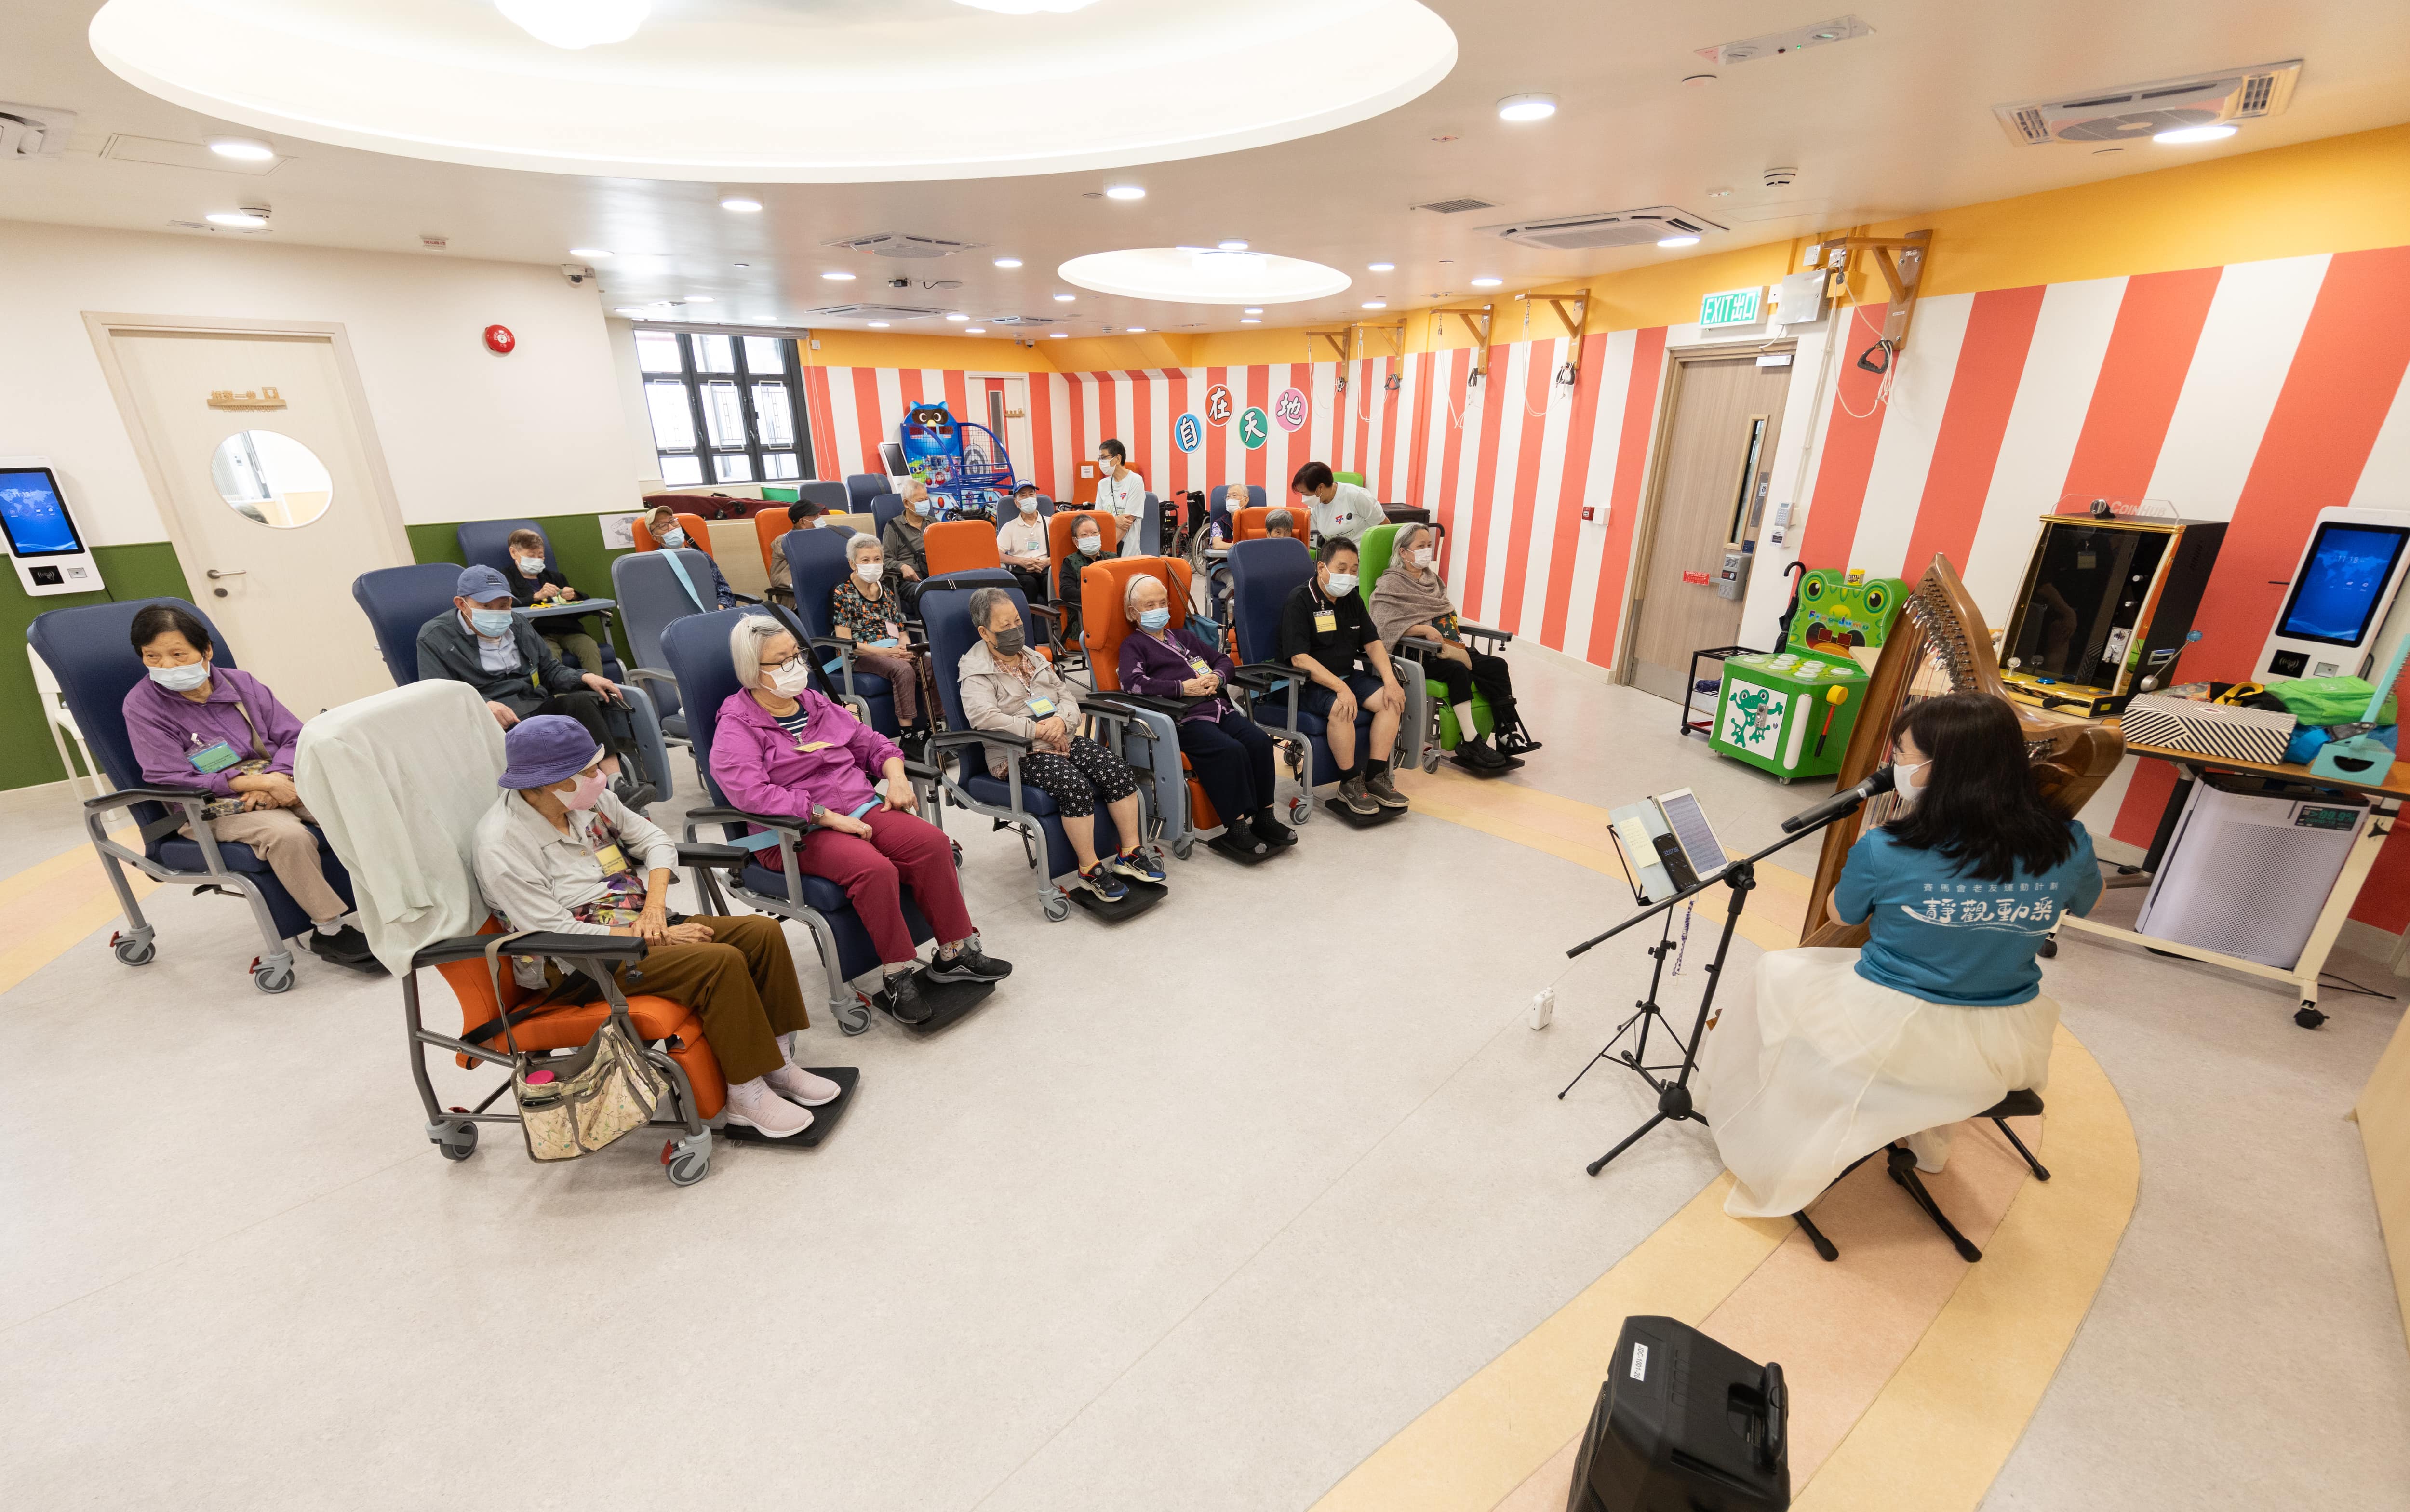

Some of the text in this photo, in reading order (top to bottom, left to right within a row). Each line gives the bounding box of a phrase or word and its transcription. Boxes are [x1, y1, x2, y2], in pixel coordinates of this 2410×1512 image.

[1703, 295, 1734, 324] EXIT
[1730, 292, 1757, 321] 出口
[1179, 387, 1302, 450] 自在天地
[1808, 609, 1870, 632] Frog Jump
[1924, 882, 2059, 893] 賽馬會老友運動計劃
[1634, 1345, 1644, 1379] JDC-1001-20
